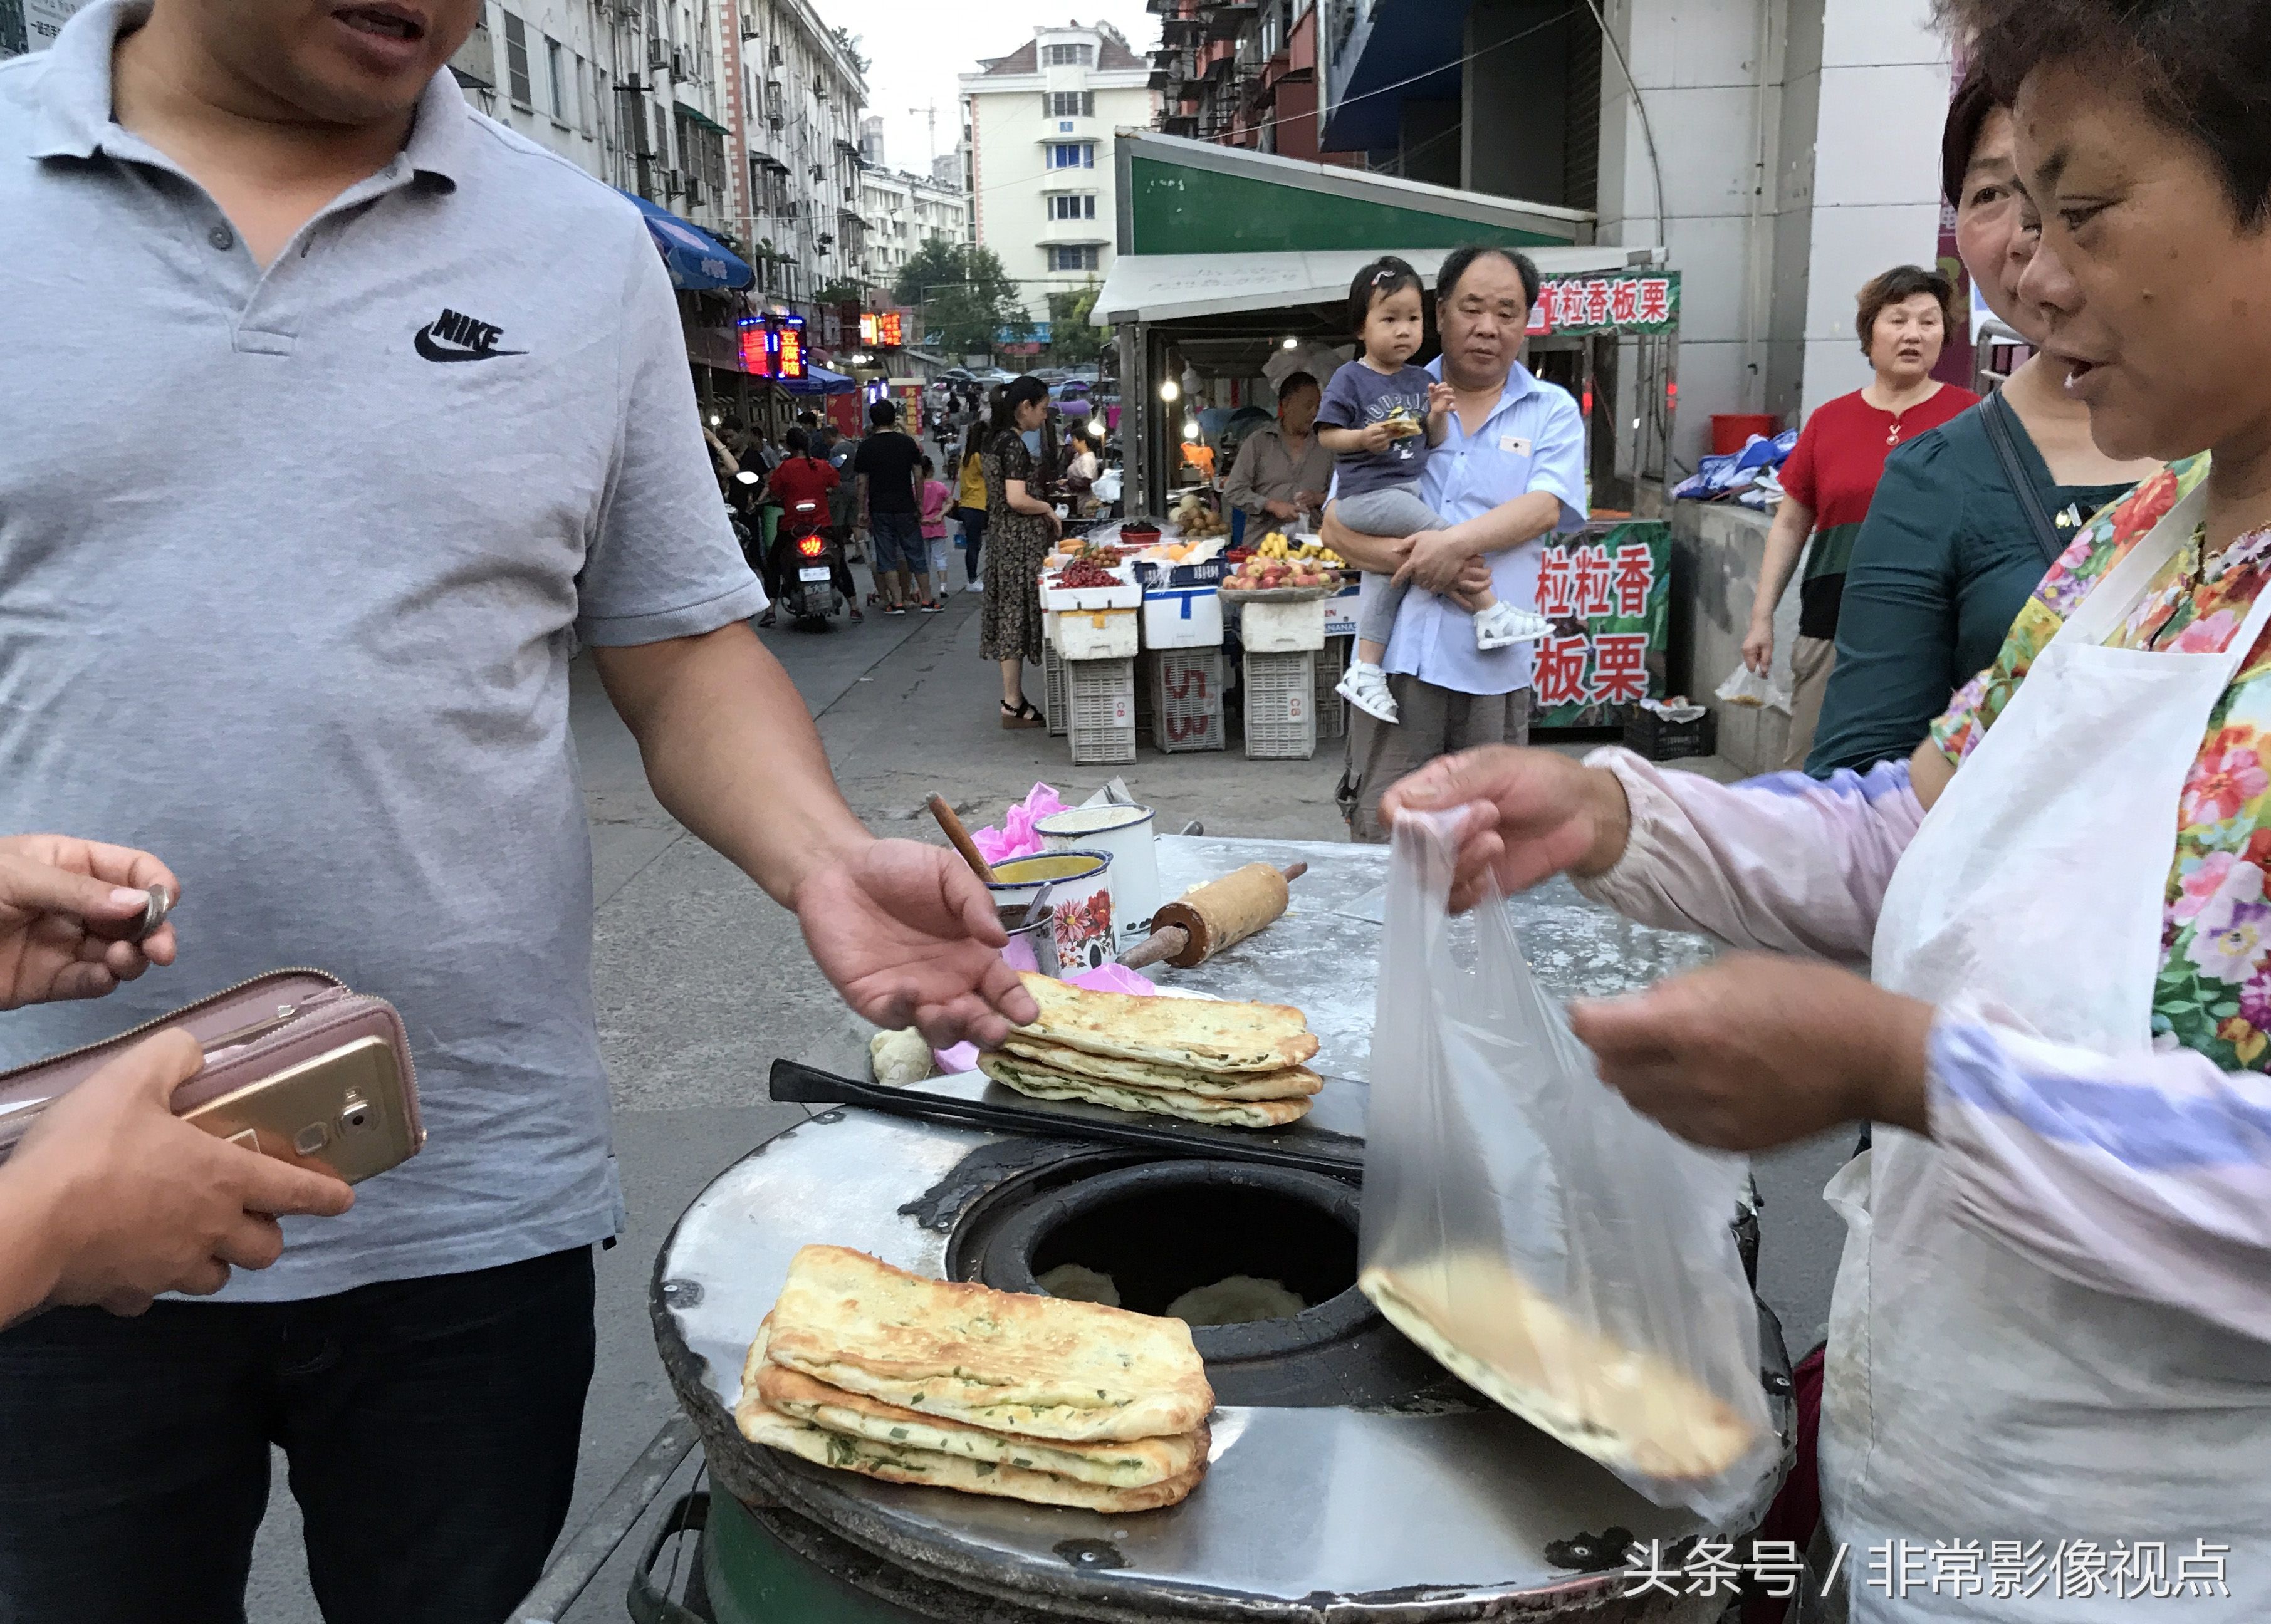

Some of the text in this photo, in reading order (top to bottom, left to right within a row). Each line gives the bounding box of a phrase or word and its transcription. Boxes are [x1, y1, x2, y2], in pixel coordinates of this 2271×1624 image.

[431, 308, 504, 351] NIKE
[780, 330, 800, 376] 豆腐脑
[1533, 544, 1654, 618] 粒粒香
[1533, 633, 1649, 706] 板栗
